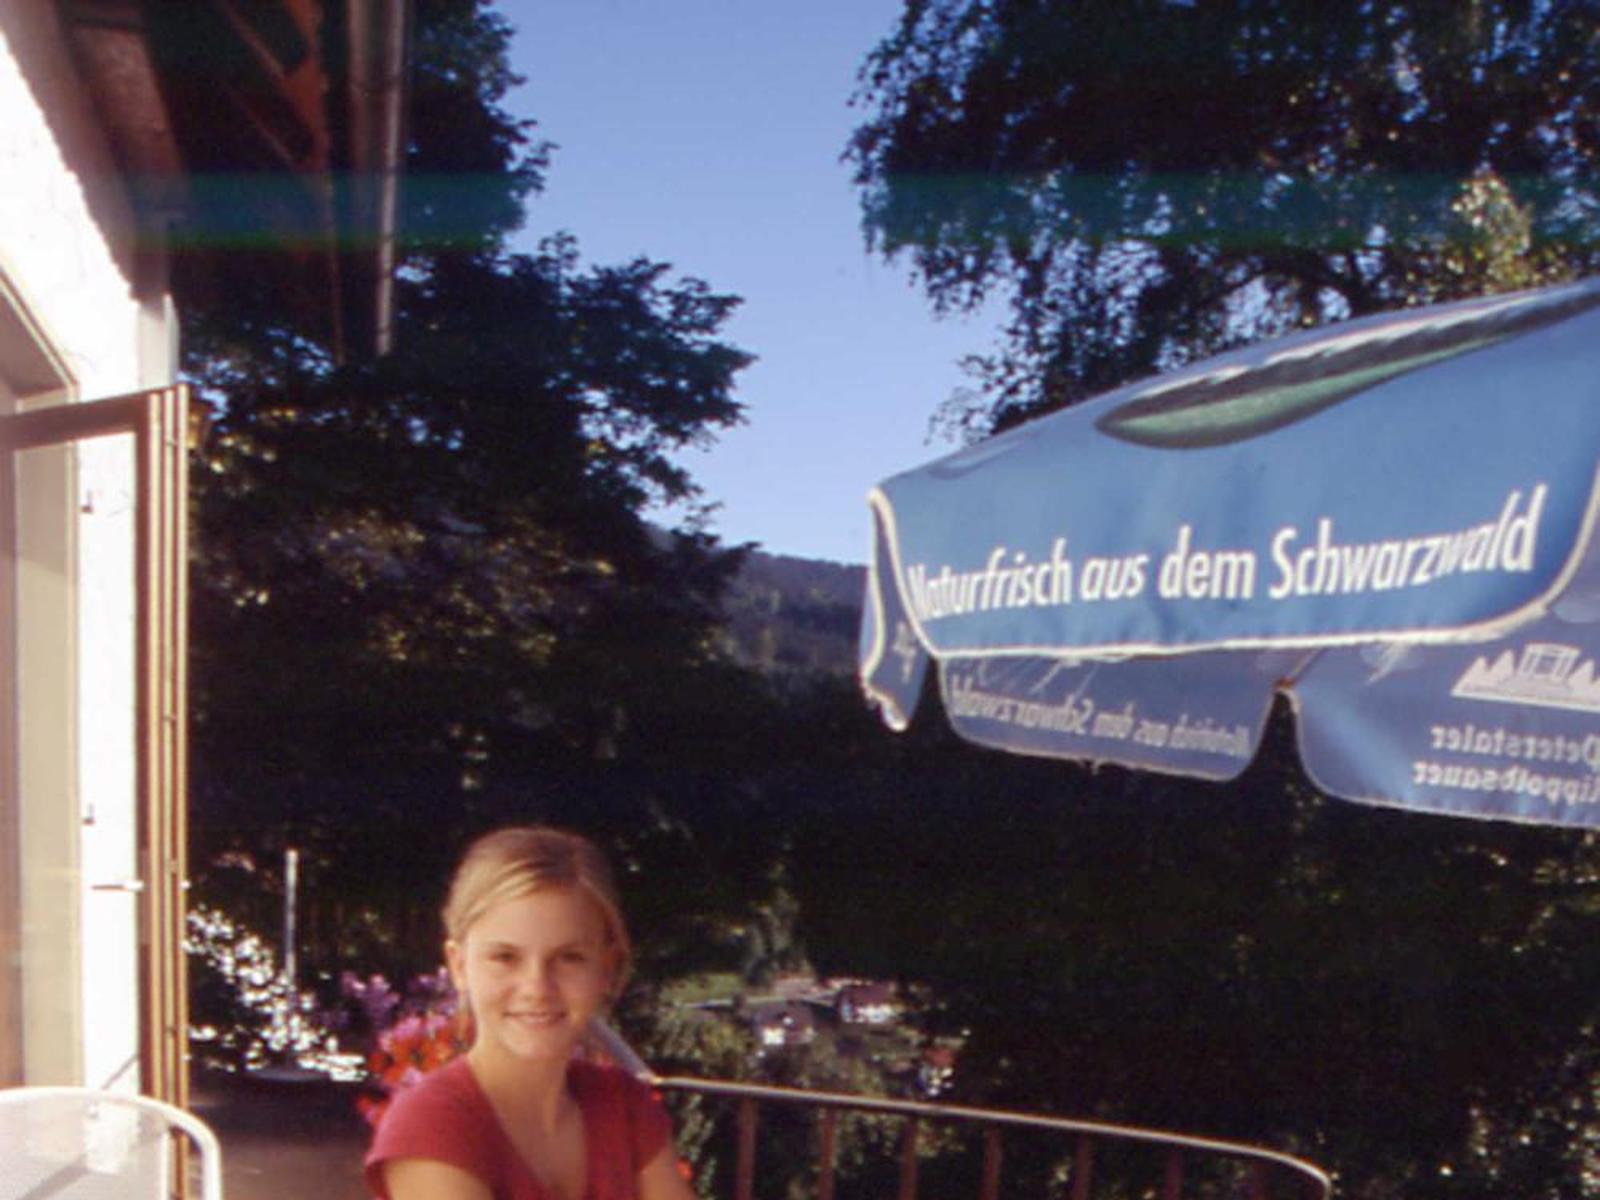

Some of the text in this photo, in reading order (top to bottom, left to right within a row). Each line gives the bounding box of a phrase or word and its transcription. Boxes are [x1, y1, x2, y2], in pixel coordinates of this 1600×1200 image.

[908, 485, 1547, 620] Naturfrisch aus dem Schwarzwald
